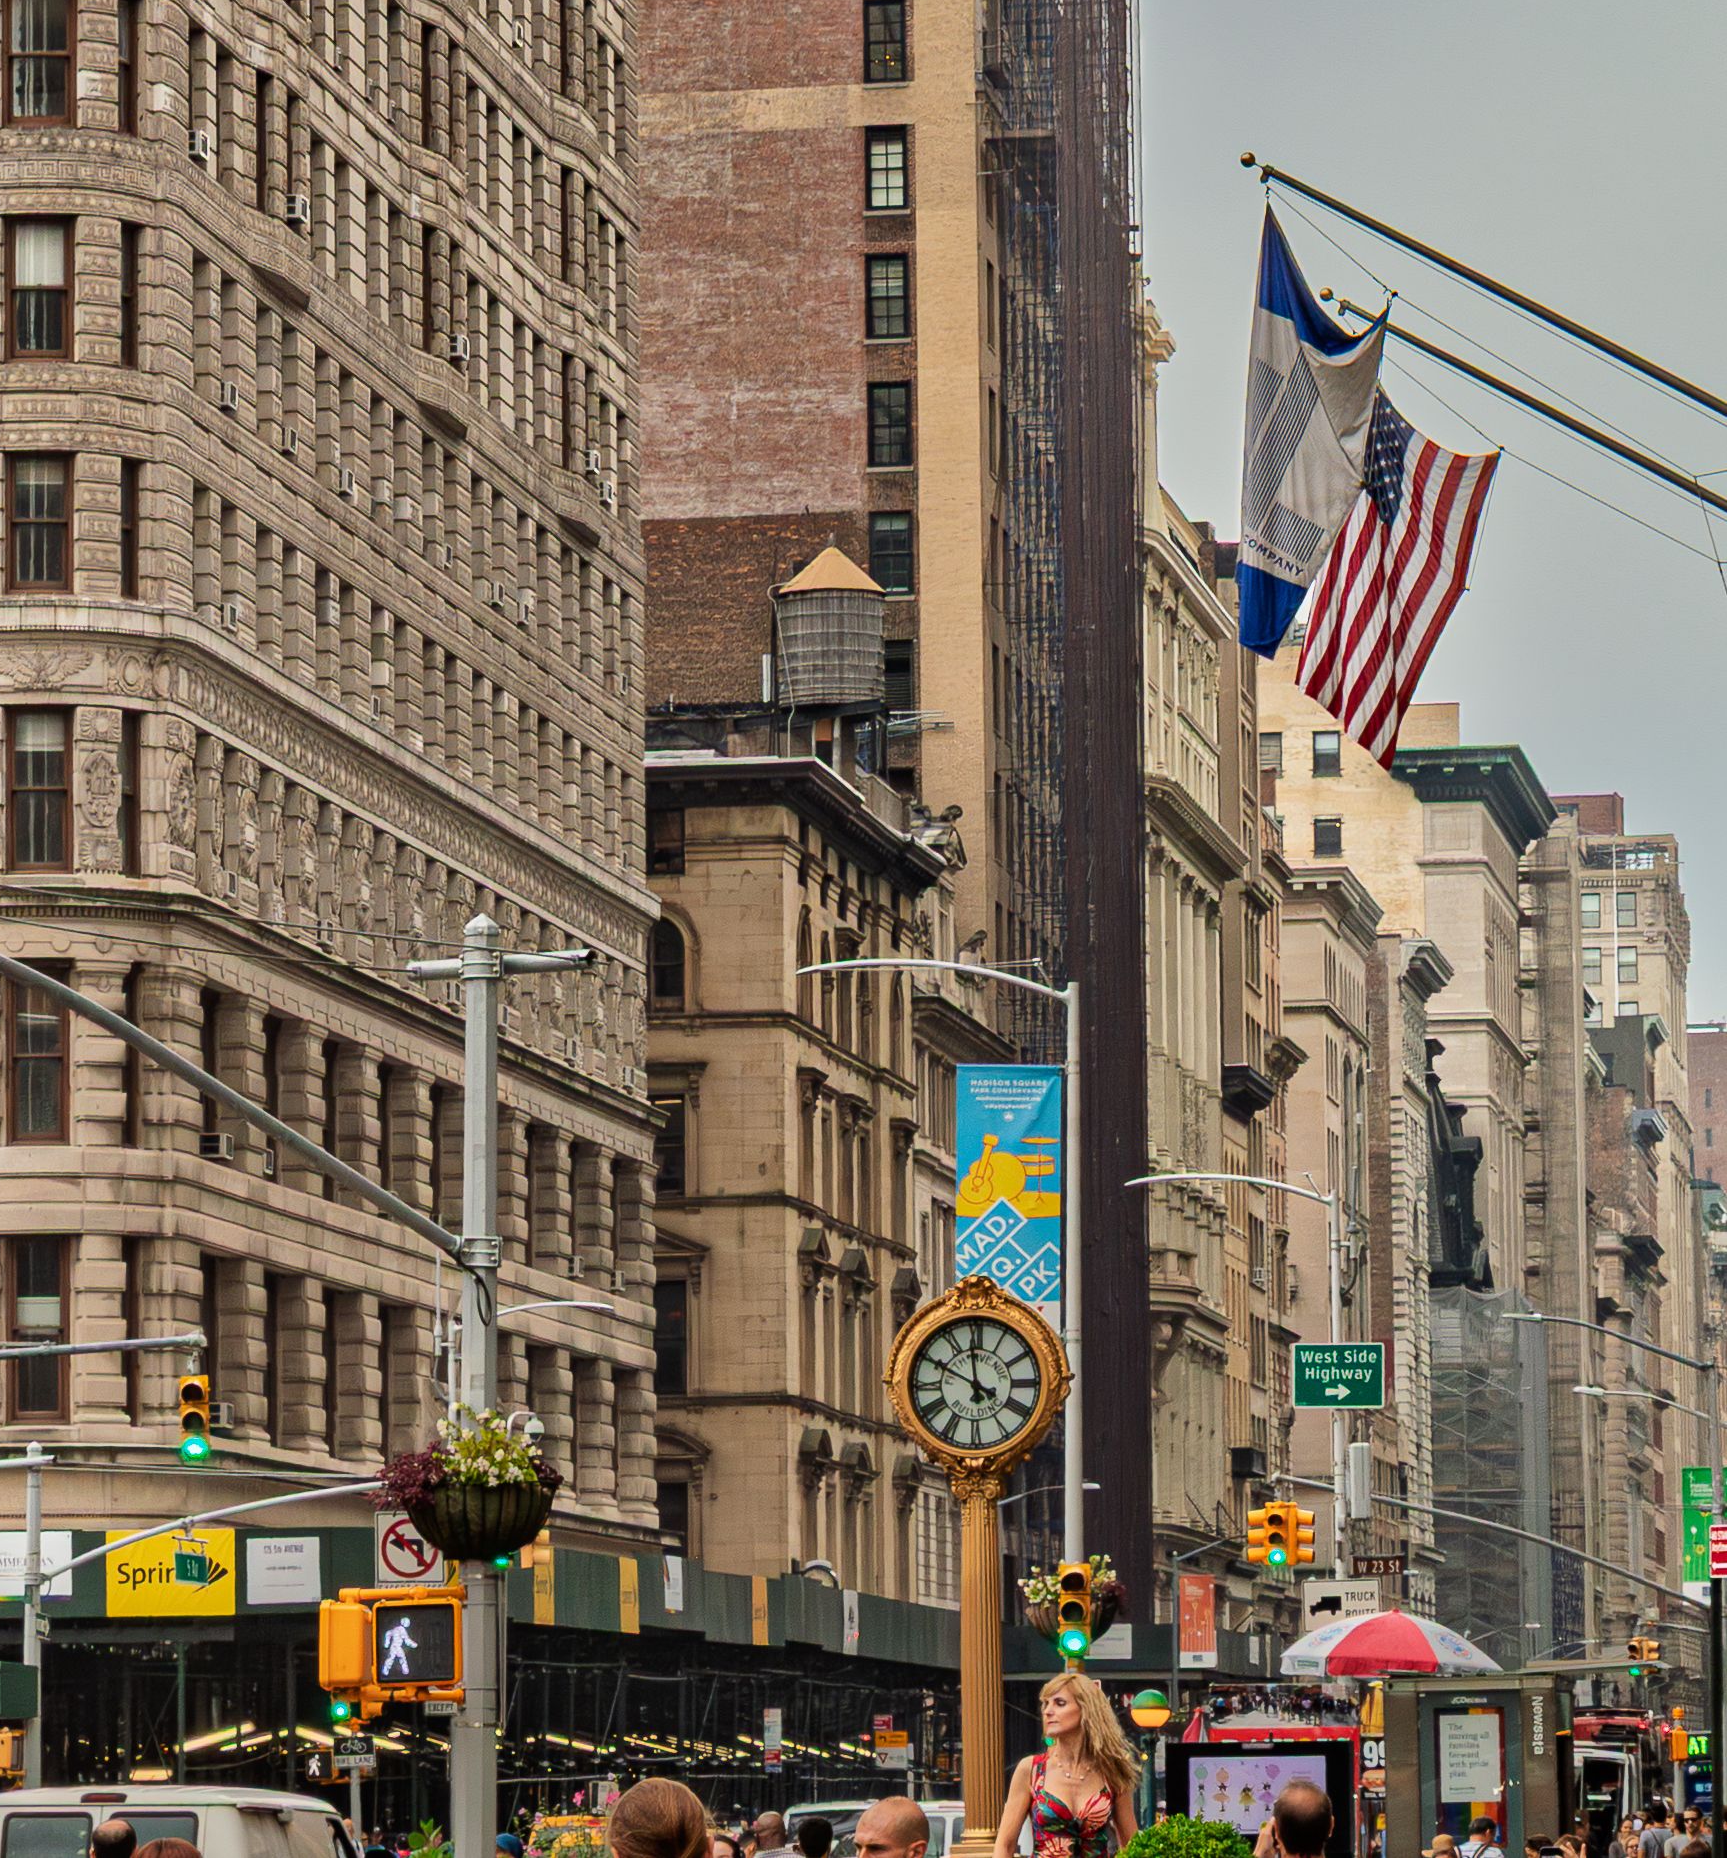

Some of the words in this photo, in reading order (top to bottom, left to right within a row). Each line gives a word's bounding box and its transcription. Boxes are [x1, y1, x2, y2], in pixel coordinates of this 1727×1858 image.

[956, 1214, 1015, 1269] MAD.
[1019, 1260, 1060, 1298] PK.
[1300, 1350, 1338, 1363] West
[1344, 1349, 1377, 1363] Side
[1305, 1366, 1372, 1383] Highway
[952, 1397, 1003, 1418] BUILDING
[1357, 1561, 1367, 1574] W
[1372, 1560, 1384, 1573] 23
[1388, 1559, 1400, 1573] St
[117, 1562, 175, 1591] Sprin
[1345, 1591, 1376, 1602] TRUCK
[1448, 1723, 1463, 1731] The
